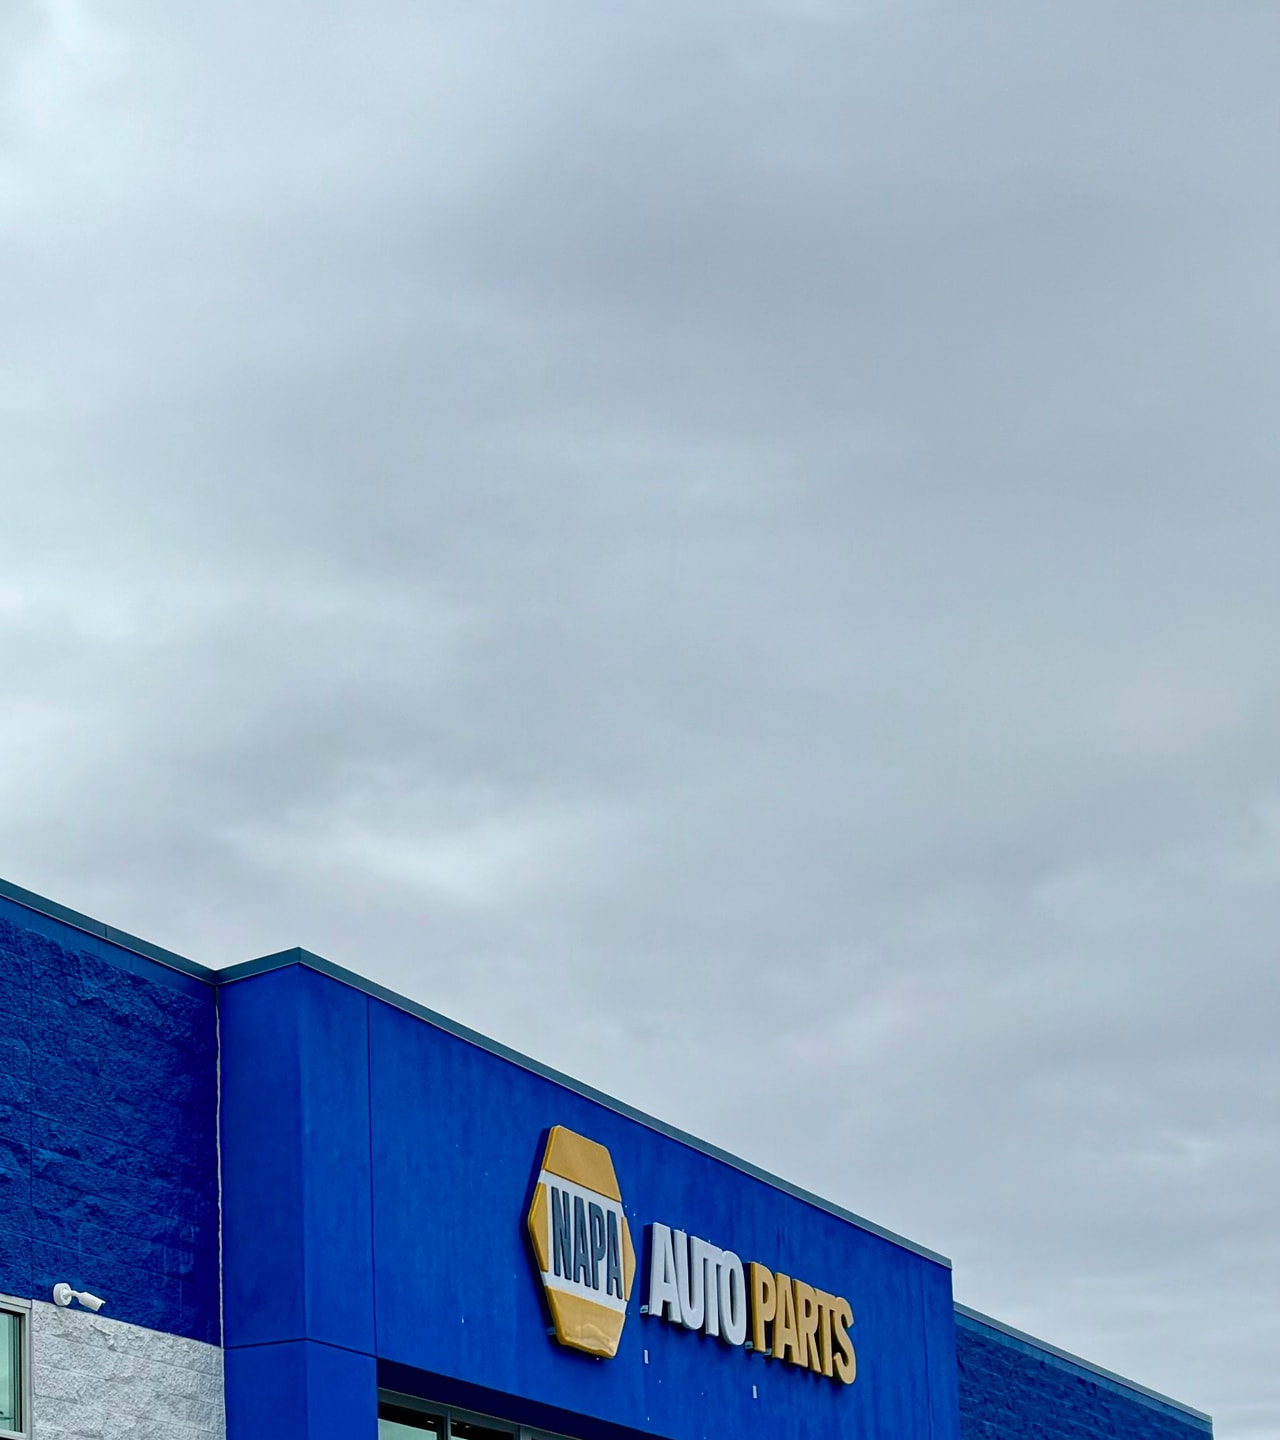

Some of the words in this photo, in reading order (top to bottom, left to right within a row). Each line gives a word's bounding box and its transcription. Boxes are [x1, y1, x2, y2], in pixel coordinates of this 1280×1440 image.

[551, 1186, 623, 1300] NAPA
[648, 1222, 747, 1346] AUTO
[750, 1261, 857, 1385] PARTS
